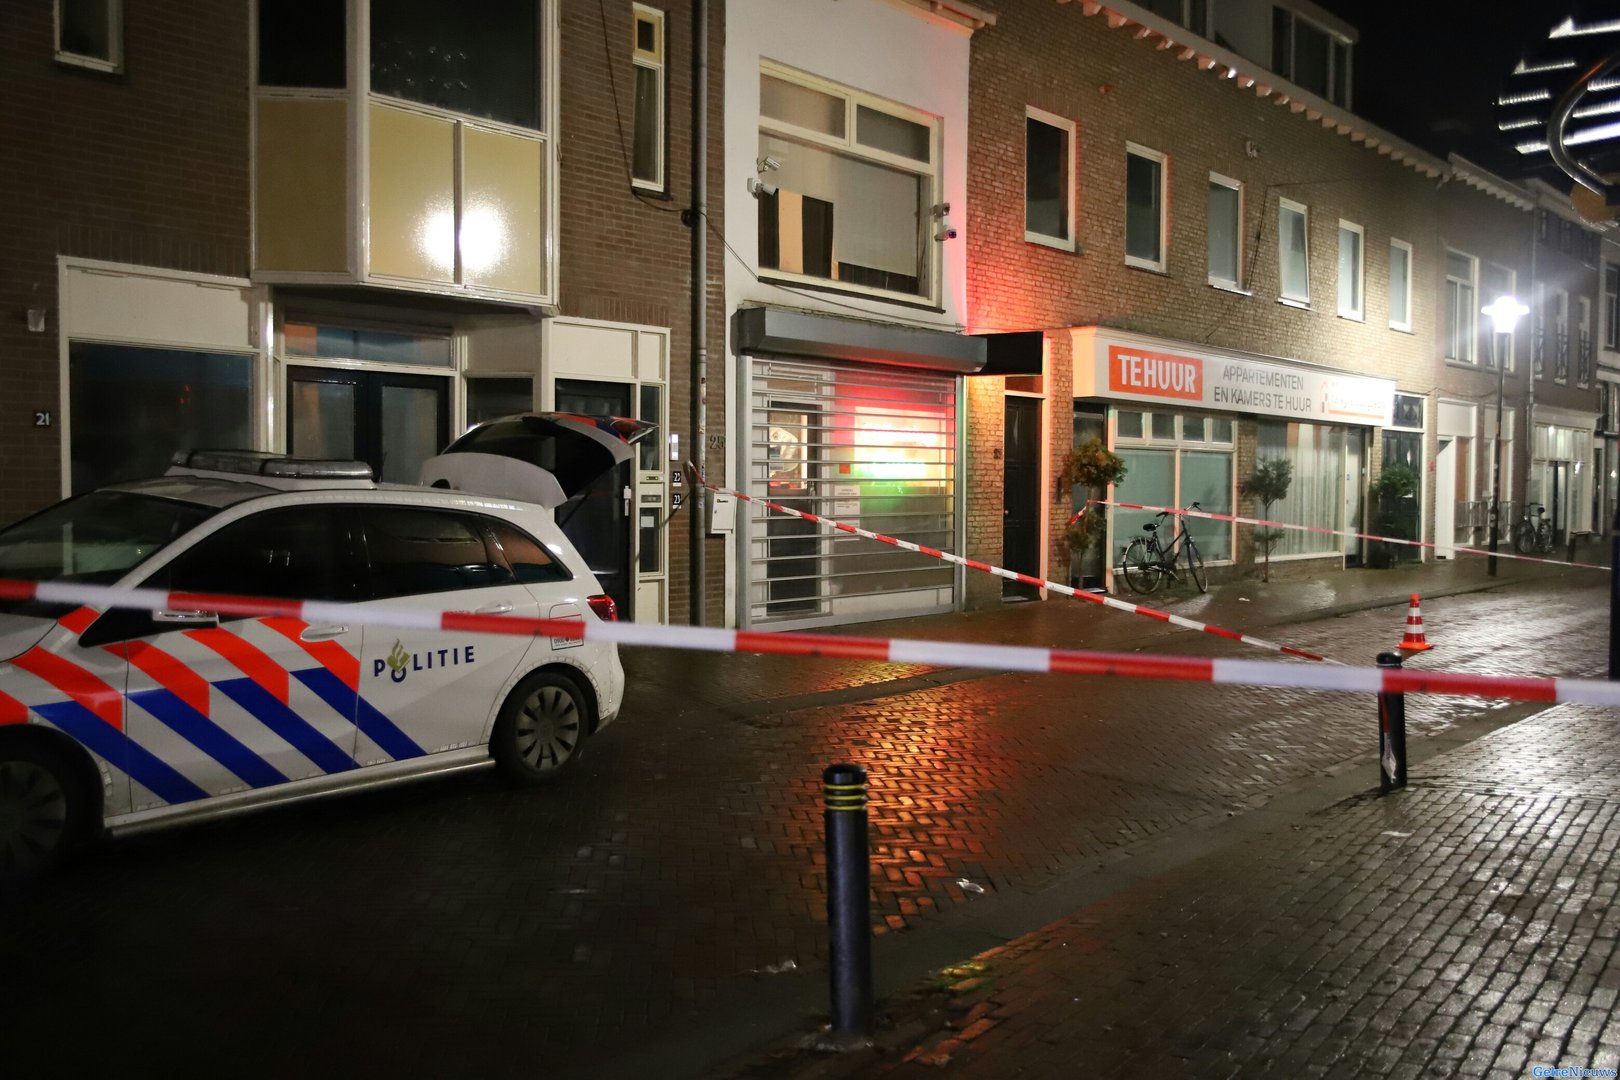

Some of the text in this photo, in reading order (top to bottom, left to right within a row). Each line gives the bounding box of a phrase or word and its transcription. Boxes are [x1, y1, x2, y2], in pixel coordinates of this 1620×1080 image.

[1222, 364, 1304, 391] APPARTEMENTEN
[1214, 385, 1229, 404] EN
[1230, 387, 1272, 409] KAMERS
[1285, 395, 1312, 413] HUUR
[35, 412, 50, 426] 21
[373, 645, 475, 683] POLITIE
